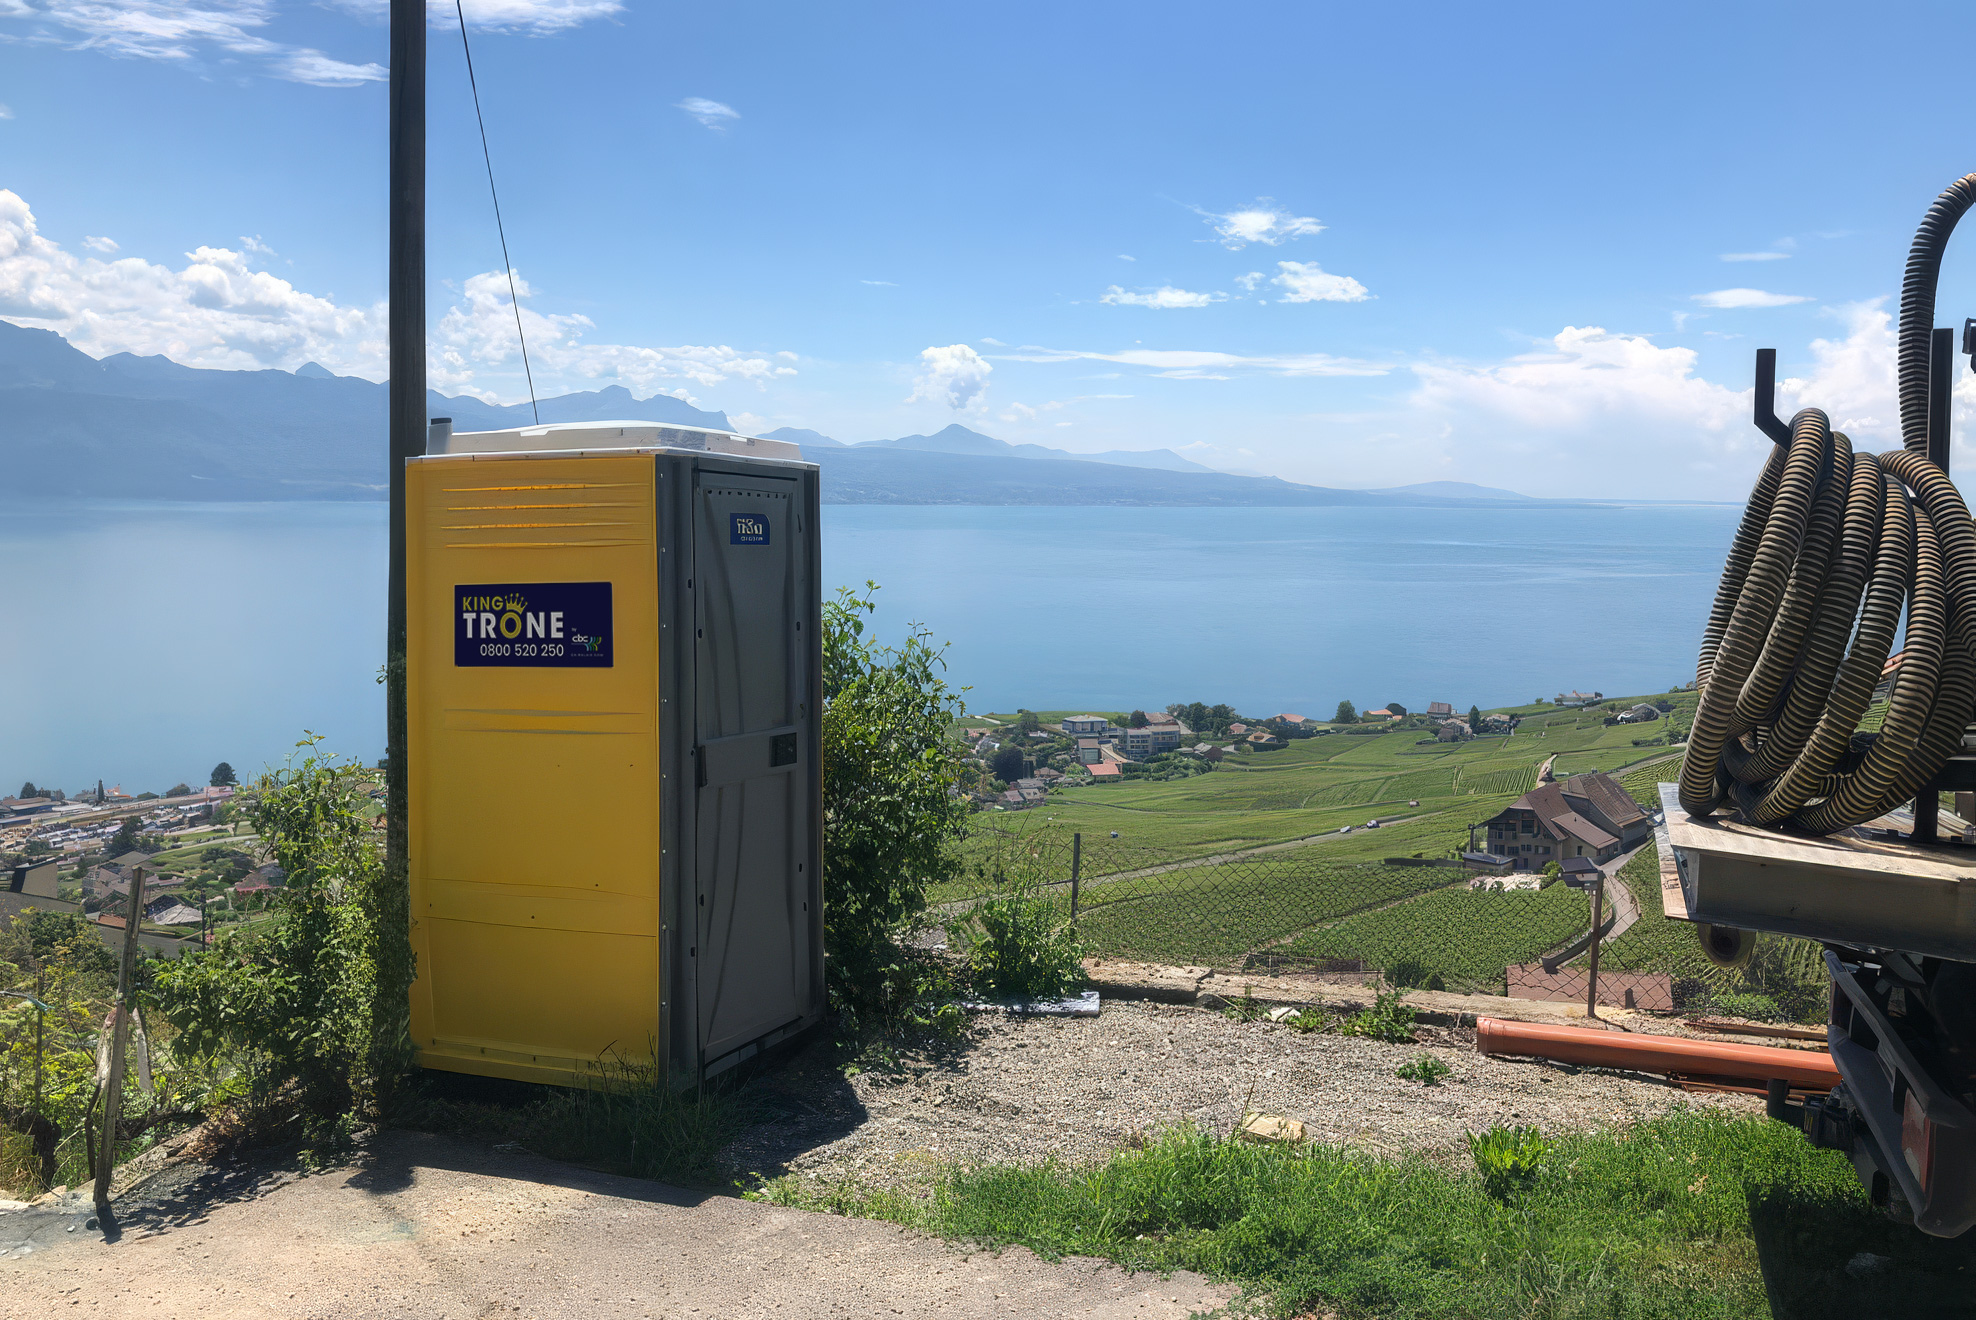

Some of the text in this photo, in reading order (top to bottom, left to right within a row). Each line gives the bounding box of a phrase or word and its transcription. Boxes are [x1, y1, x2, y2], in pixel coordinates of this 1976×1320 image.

[462, 596, 504, 611] KING
[462, 611, 564, 639] TRONE
[571, 634, 589, 643] cbc
[479, 644, 564, 657] 0800 520 250
